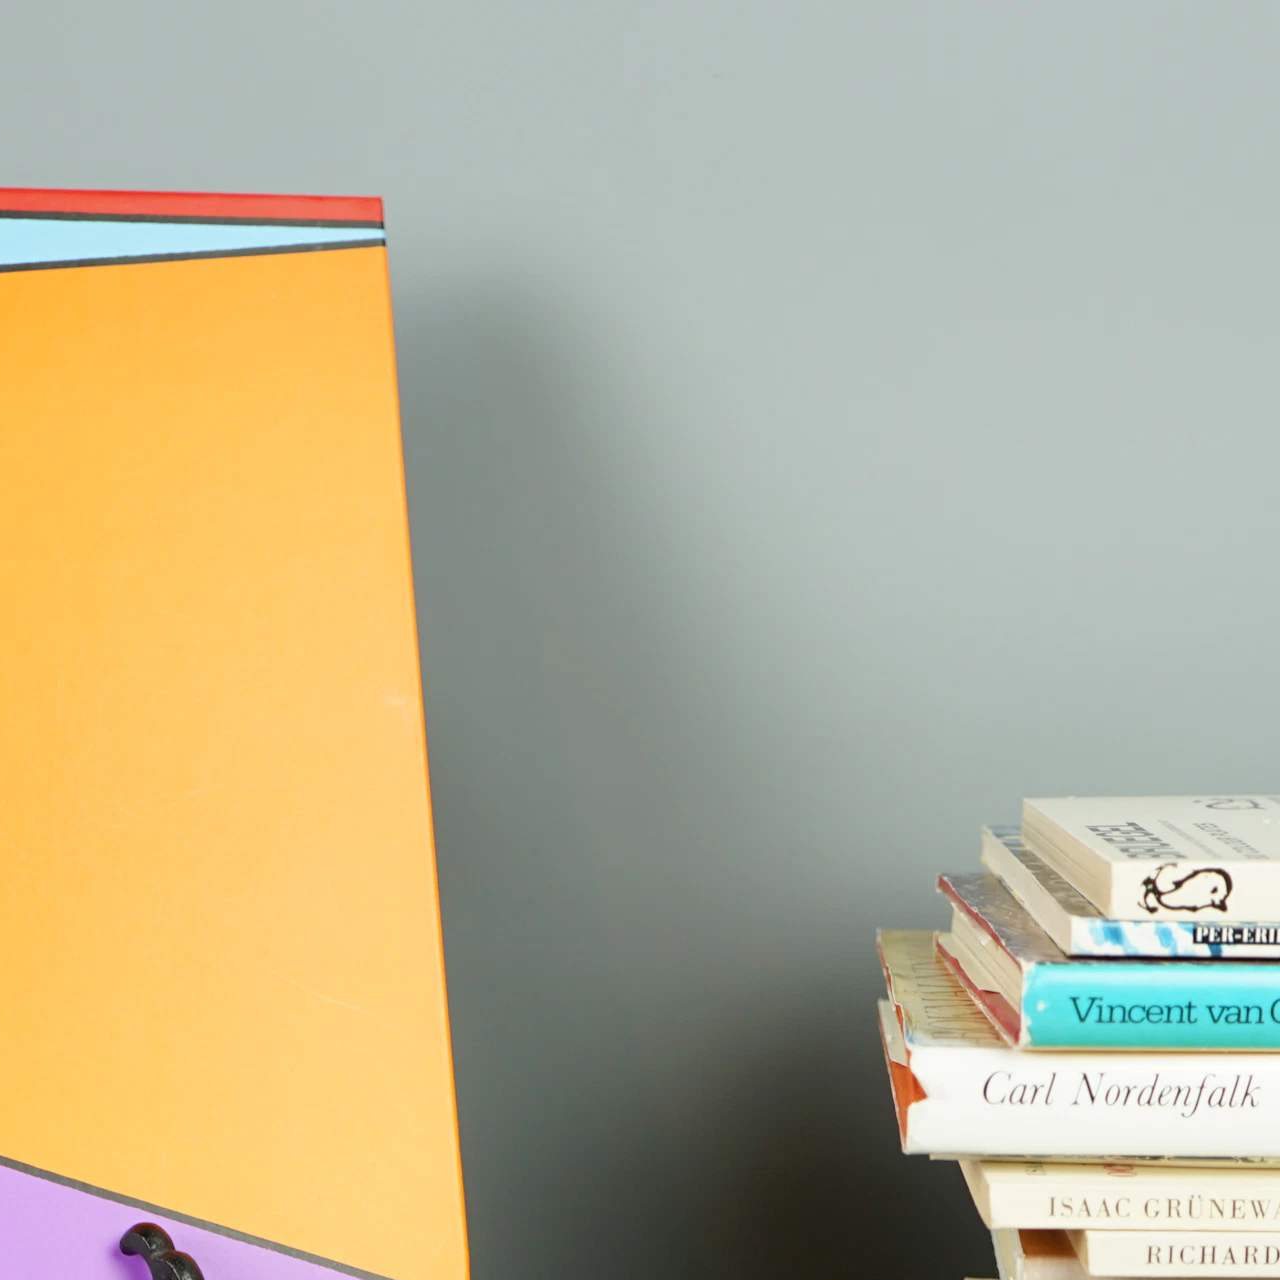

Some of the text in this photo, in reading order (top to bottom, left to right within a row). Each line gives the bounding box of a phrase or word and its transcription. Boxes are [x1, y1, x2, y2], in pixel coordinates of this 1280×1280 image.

[1069, 996, 1198, 1025] Vincent
[1208, 1003, 1264, 1025] van
[982, 1070, 1054, 1106] Carl
[1072, 1072, 1262, 1118] Nordenfalk
[1047, 1196, 1131, 1219] ISAAC
[1146, 1244, 1280, 1266] RICHARD
